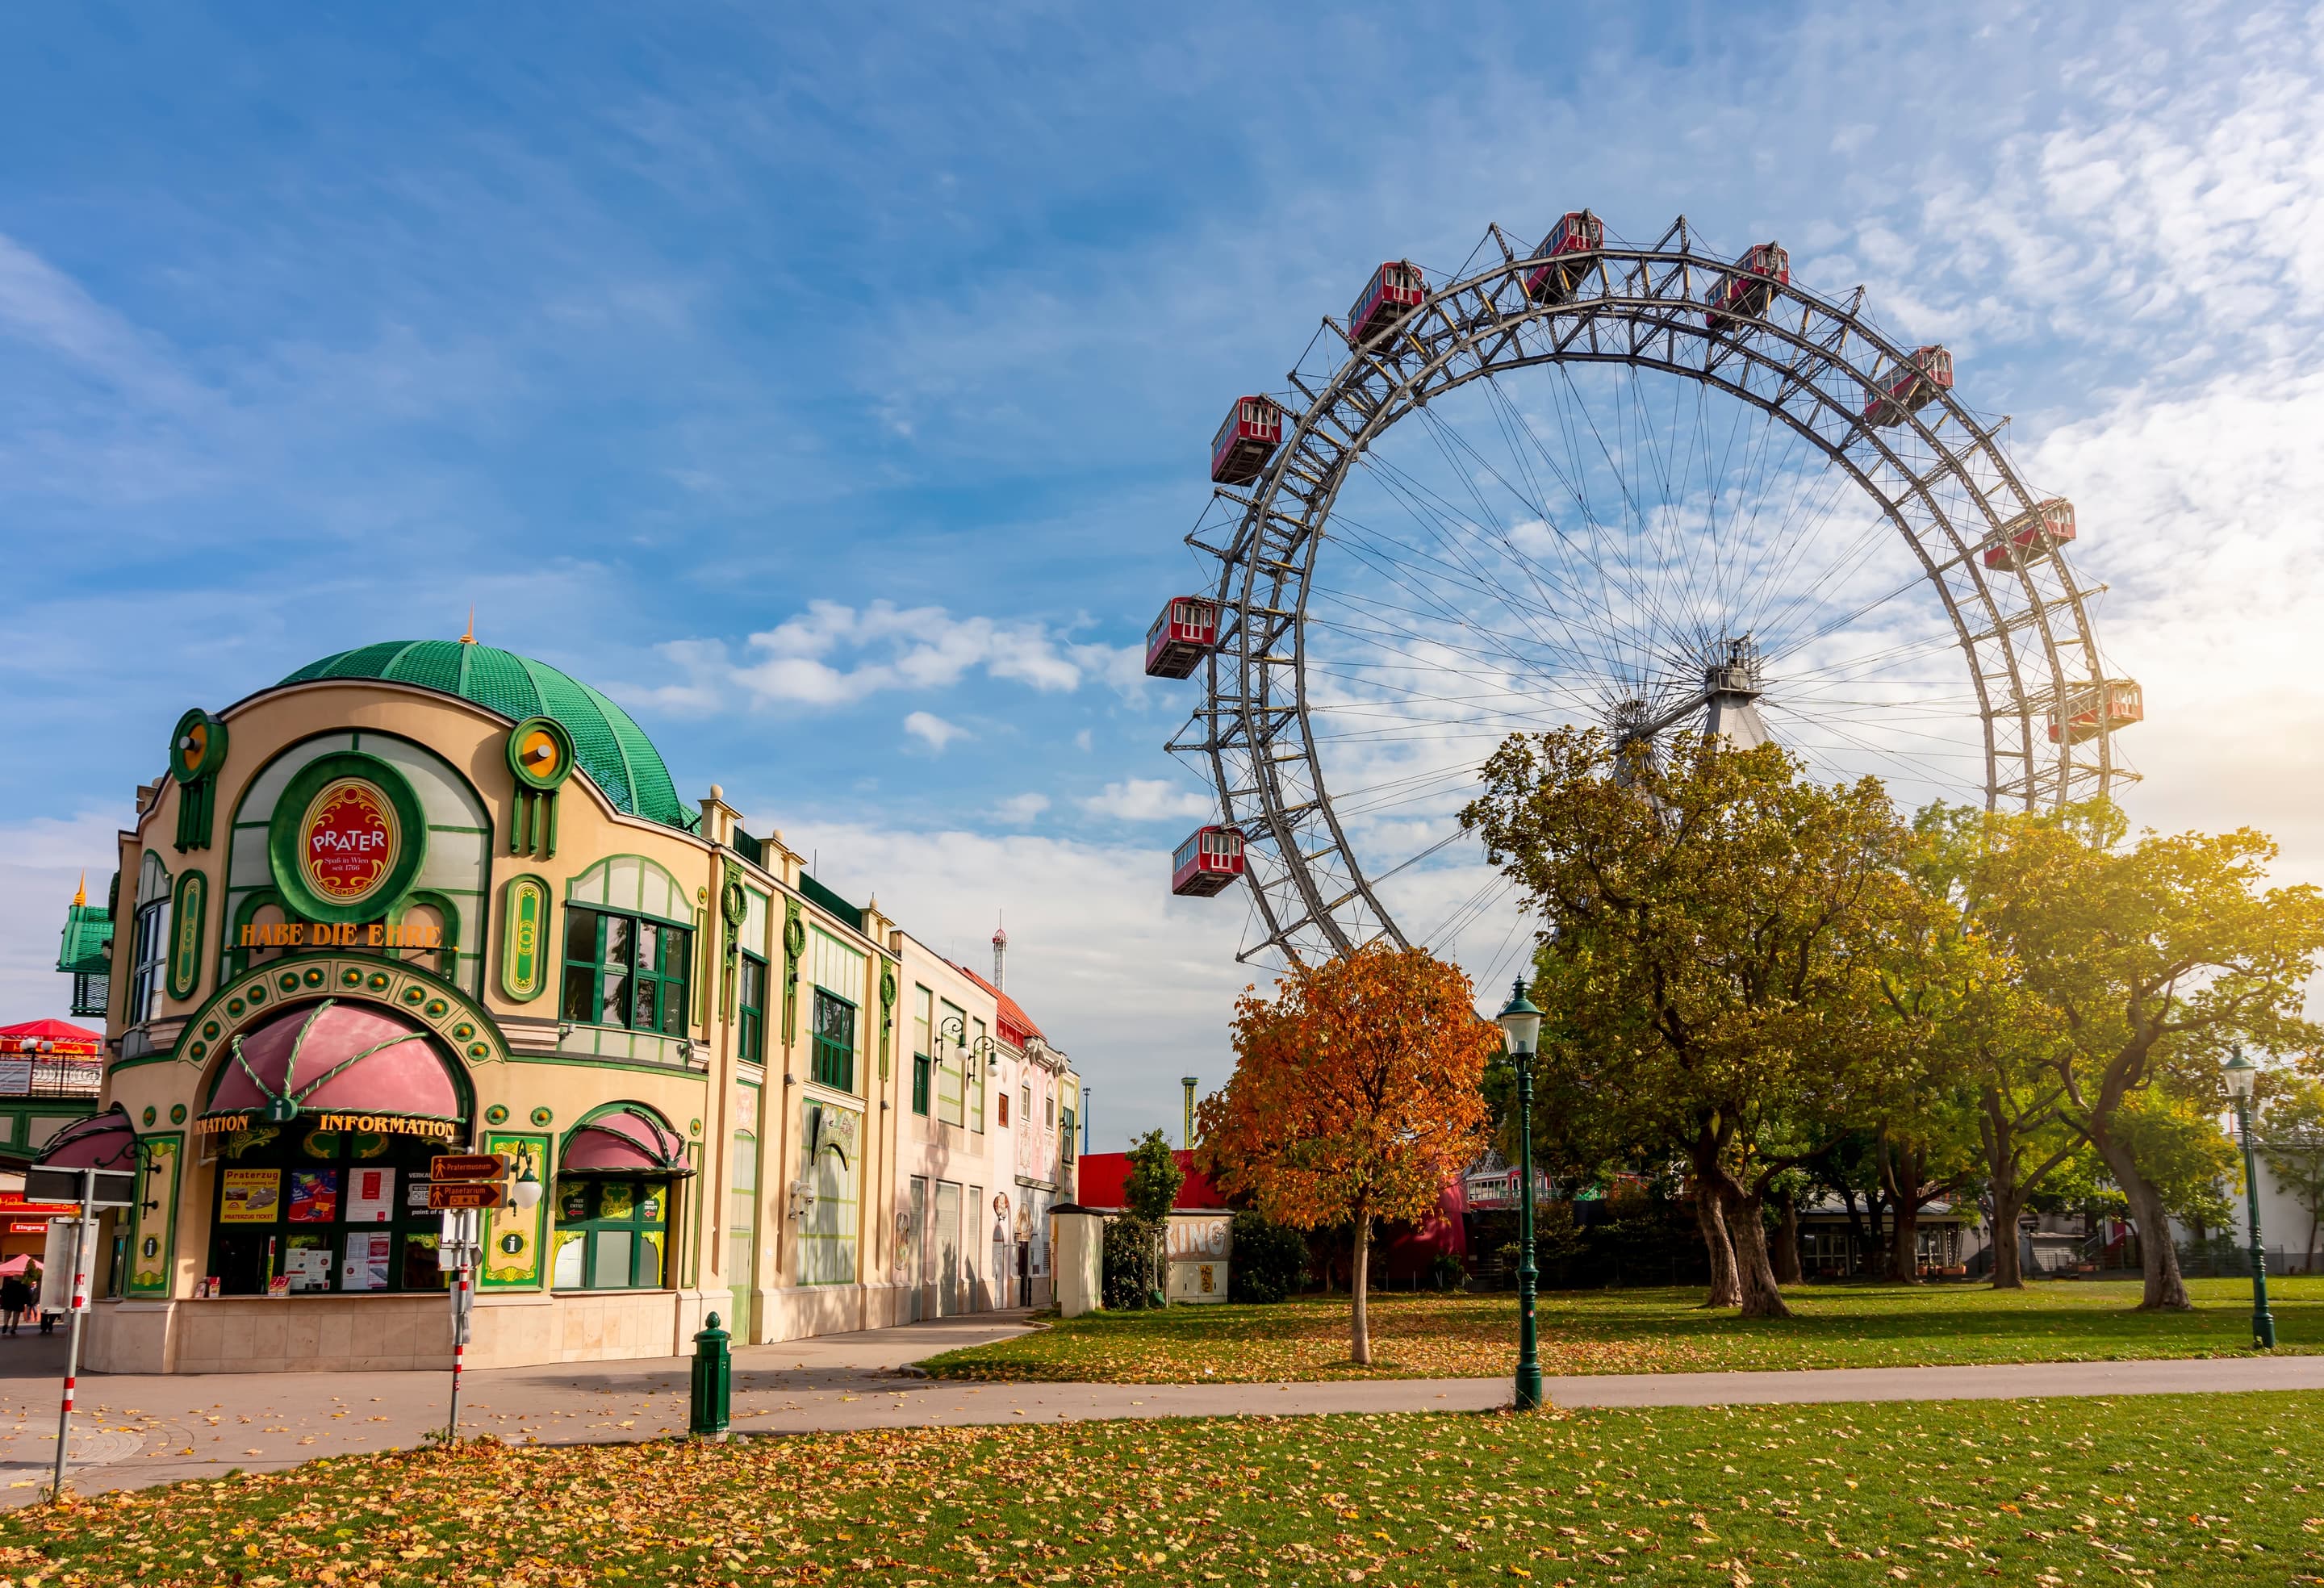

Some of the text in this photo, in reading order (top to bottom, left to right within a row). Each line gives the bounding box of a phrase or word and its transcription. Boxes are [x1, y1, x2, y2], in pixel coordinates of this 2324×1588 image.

[312, 830, 386, 852] PRATER
[240, 923, 441, 947] HABE DIE EHRE
[320, 1115, 455, 1138] INFORMATION
[227, 1172, 278, 1181] Praterzug
